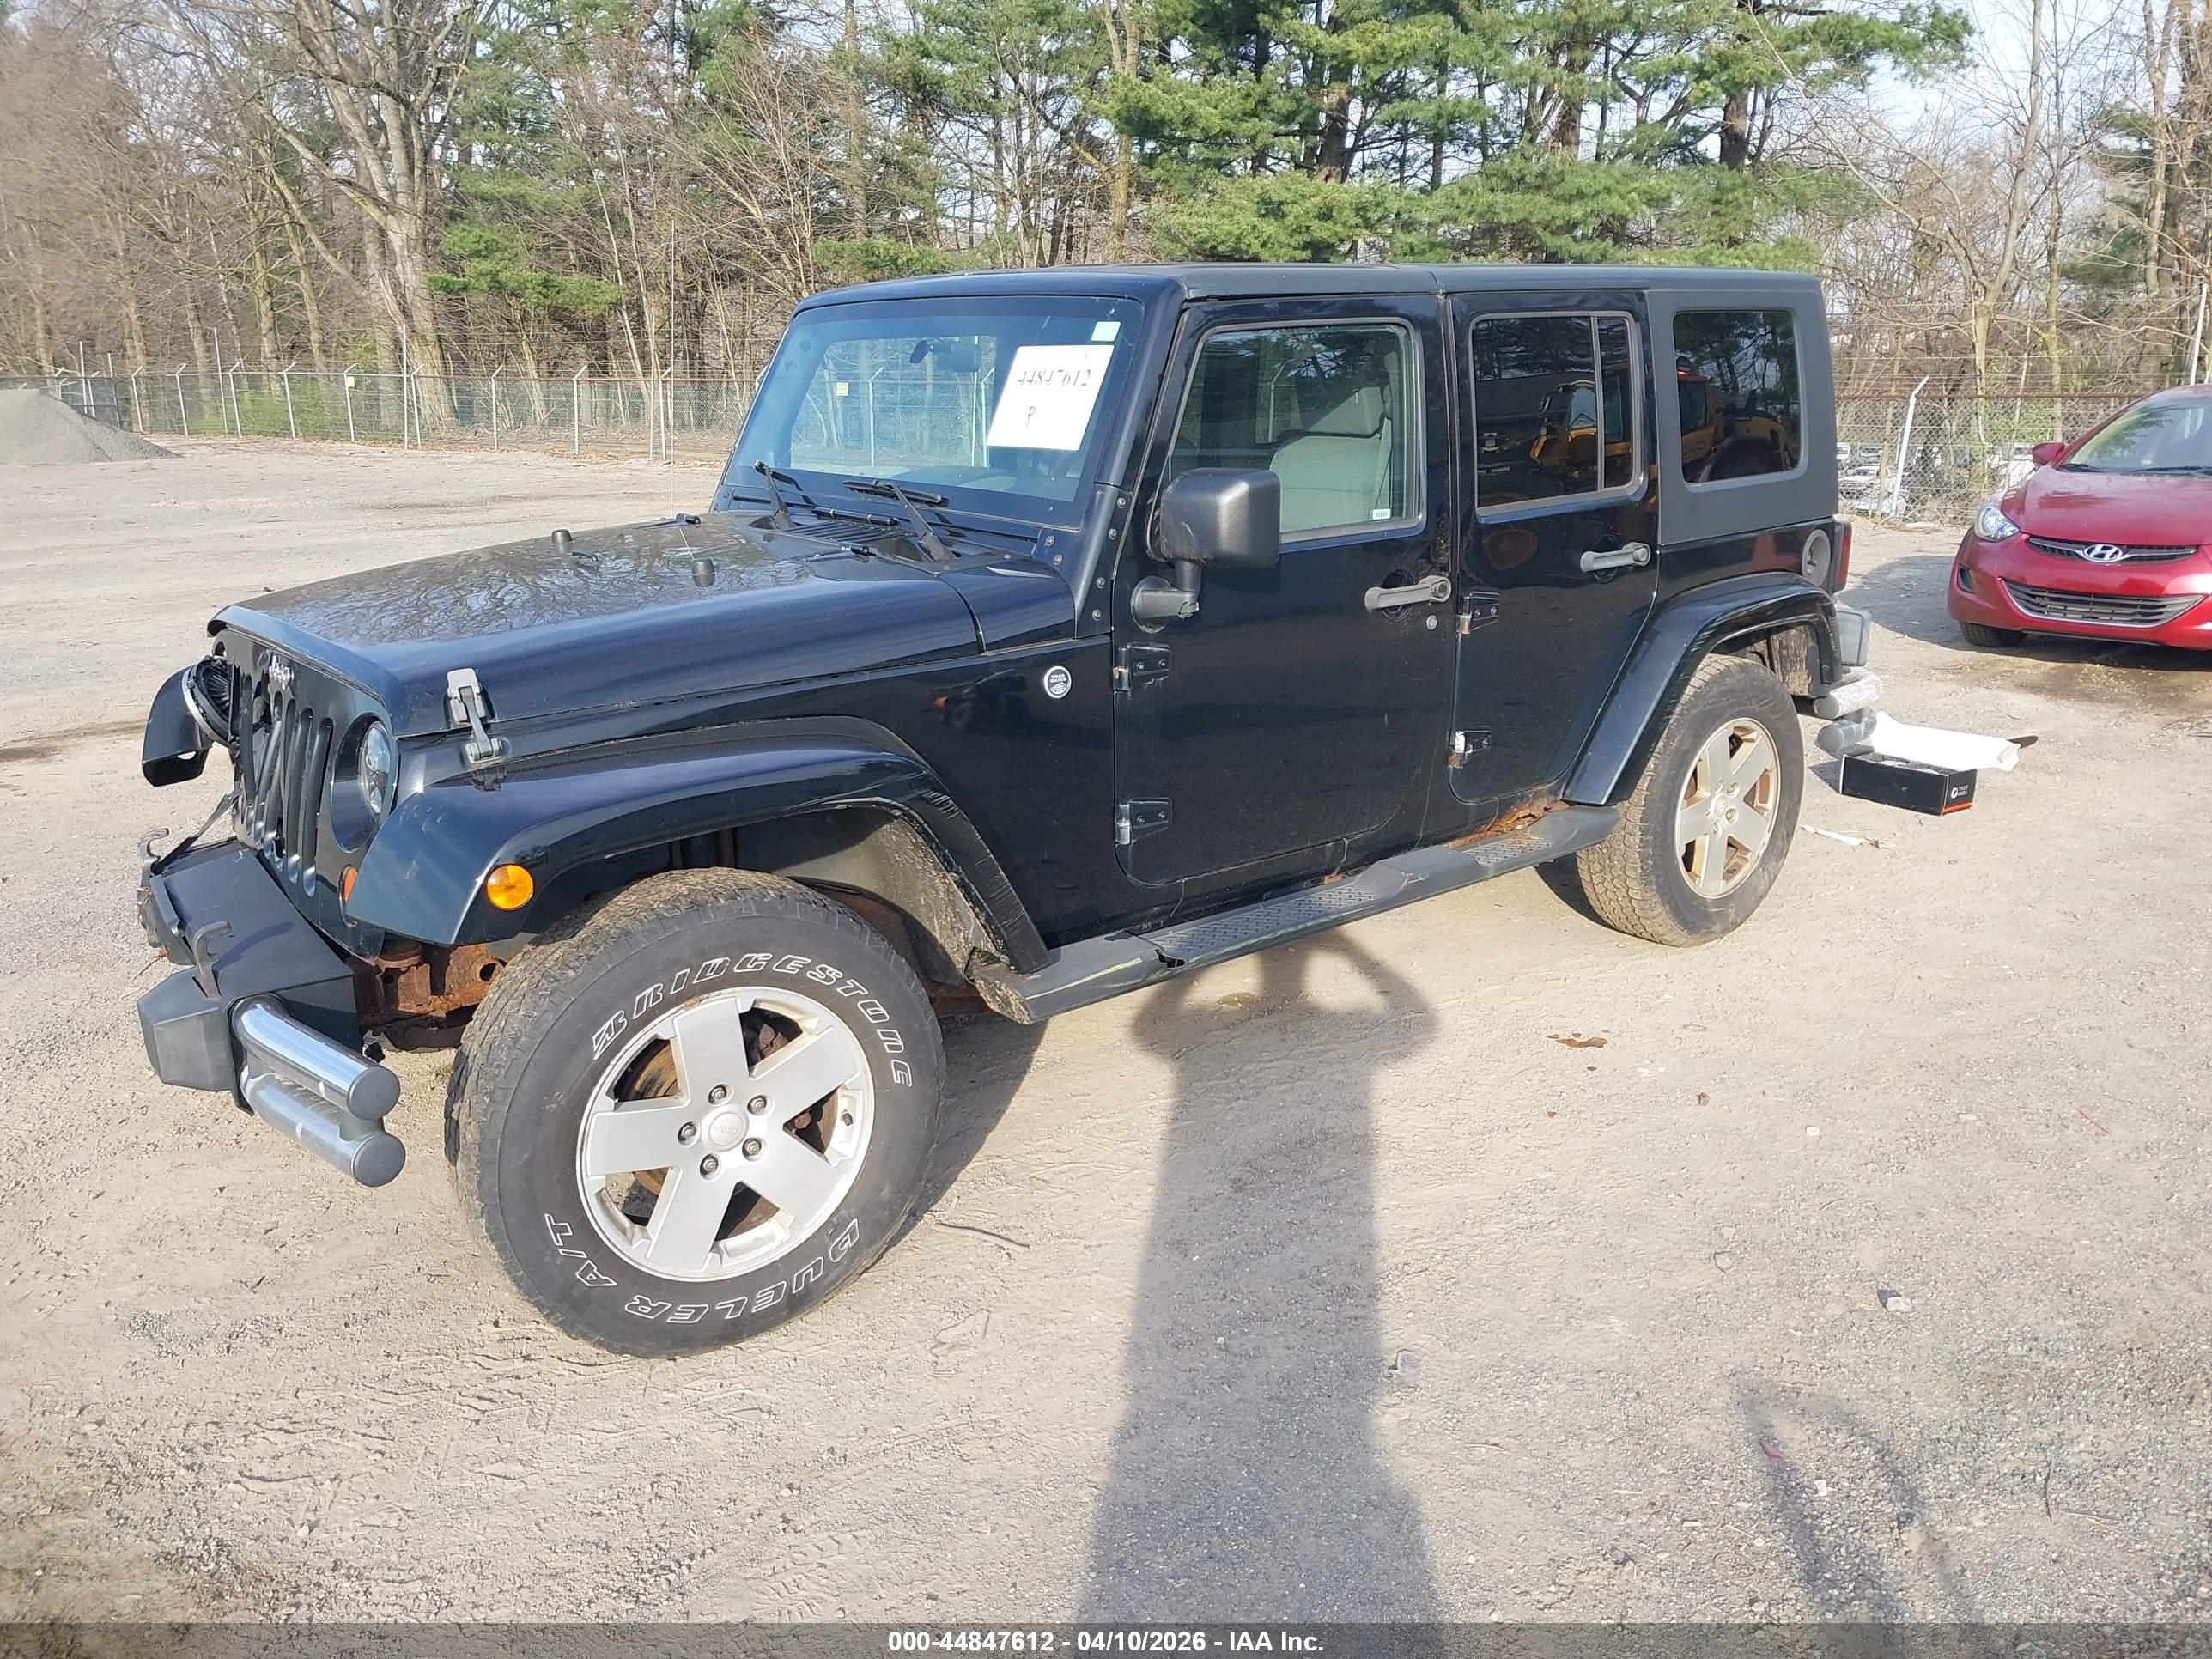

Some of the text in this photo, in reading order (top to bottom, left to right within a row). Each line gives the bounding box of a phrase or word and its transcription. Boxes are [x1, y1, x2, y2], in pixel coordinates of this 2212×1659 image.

[593, 953, 912, 1087] BRIDGESTONE
[544, 1213, 859, 1324] DUELER A/T
